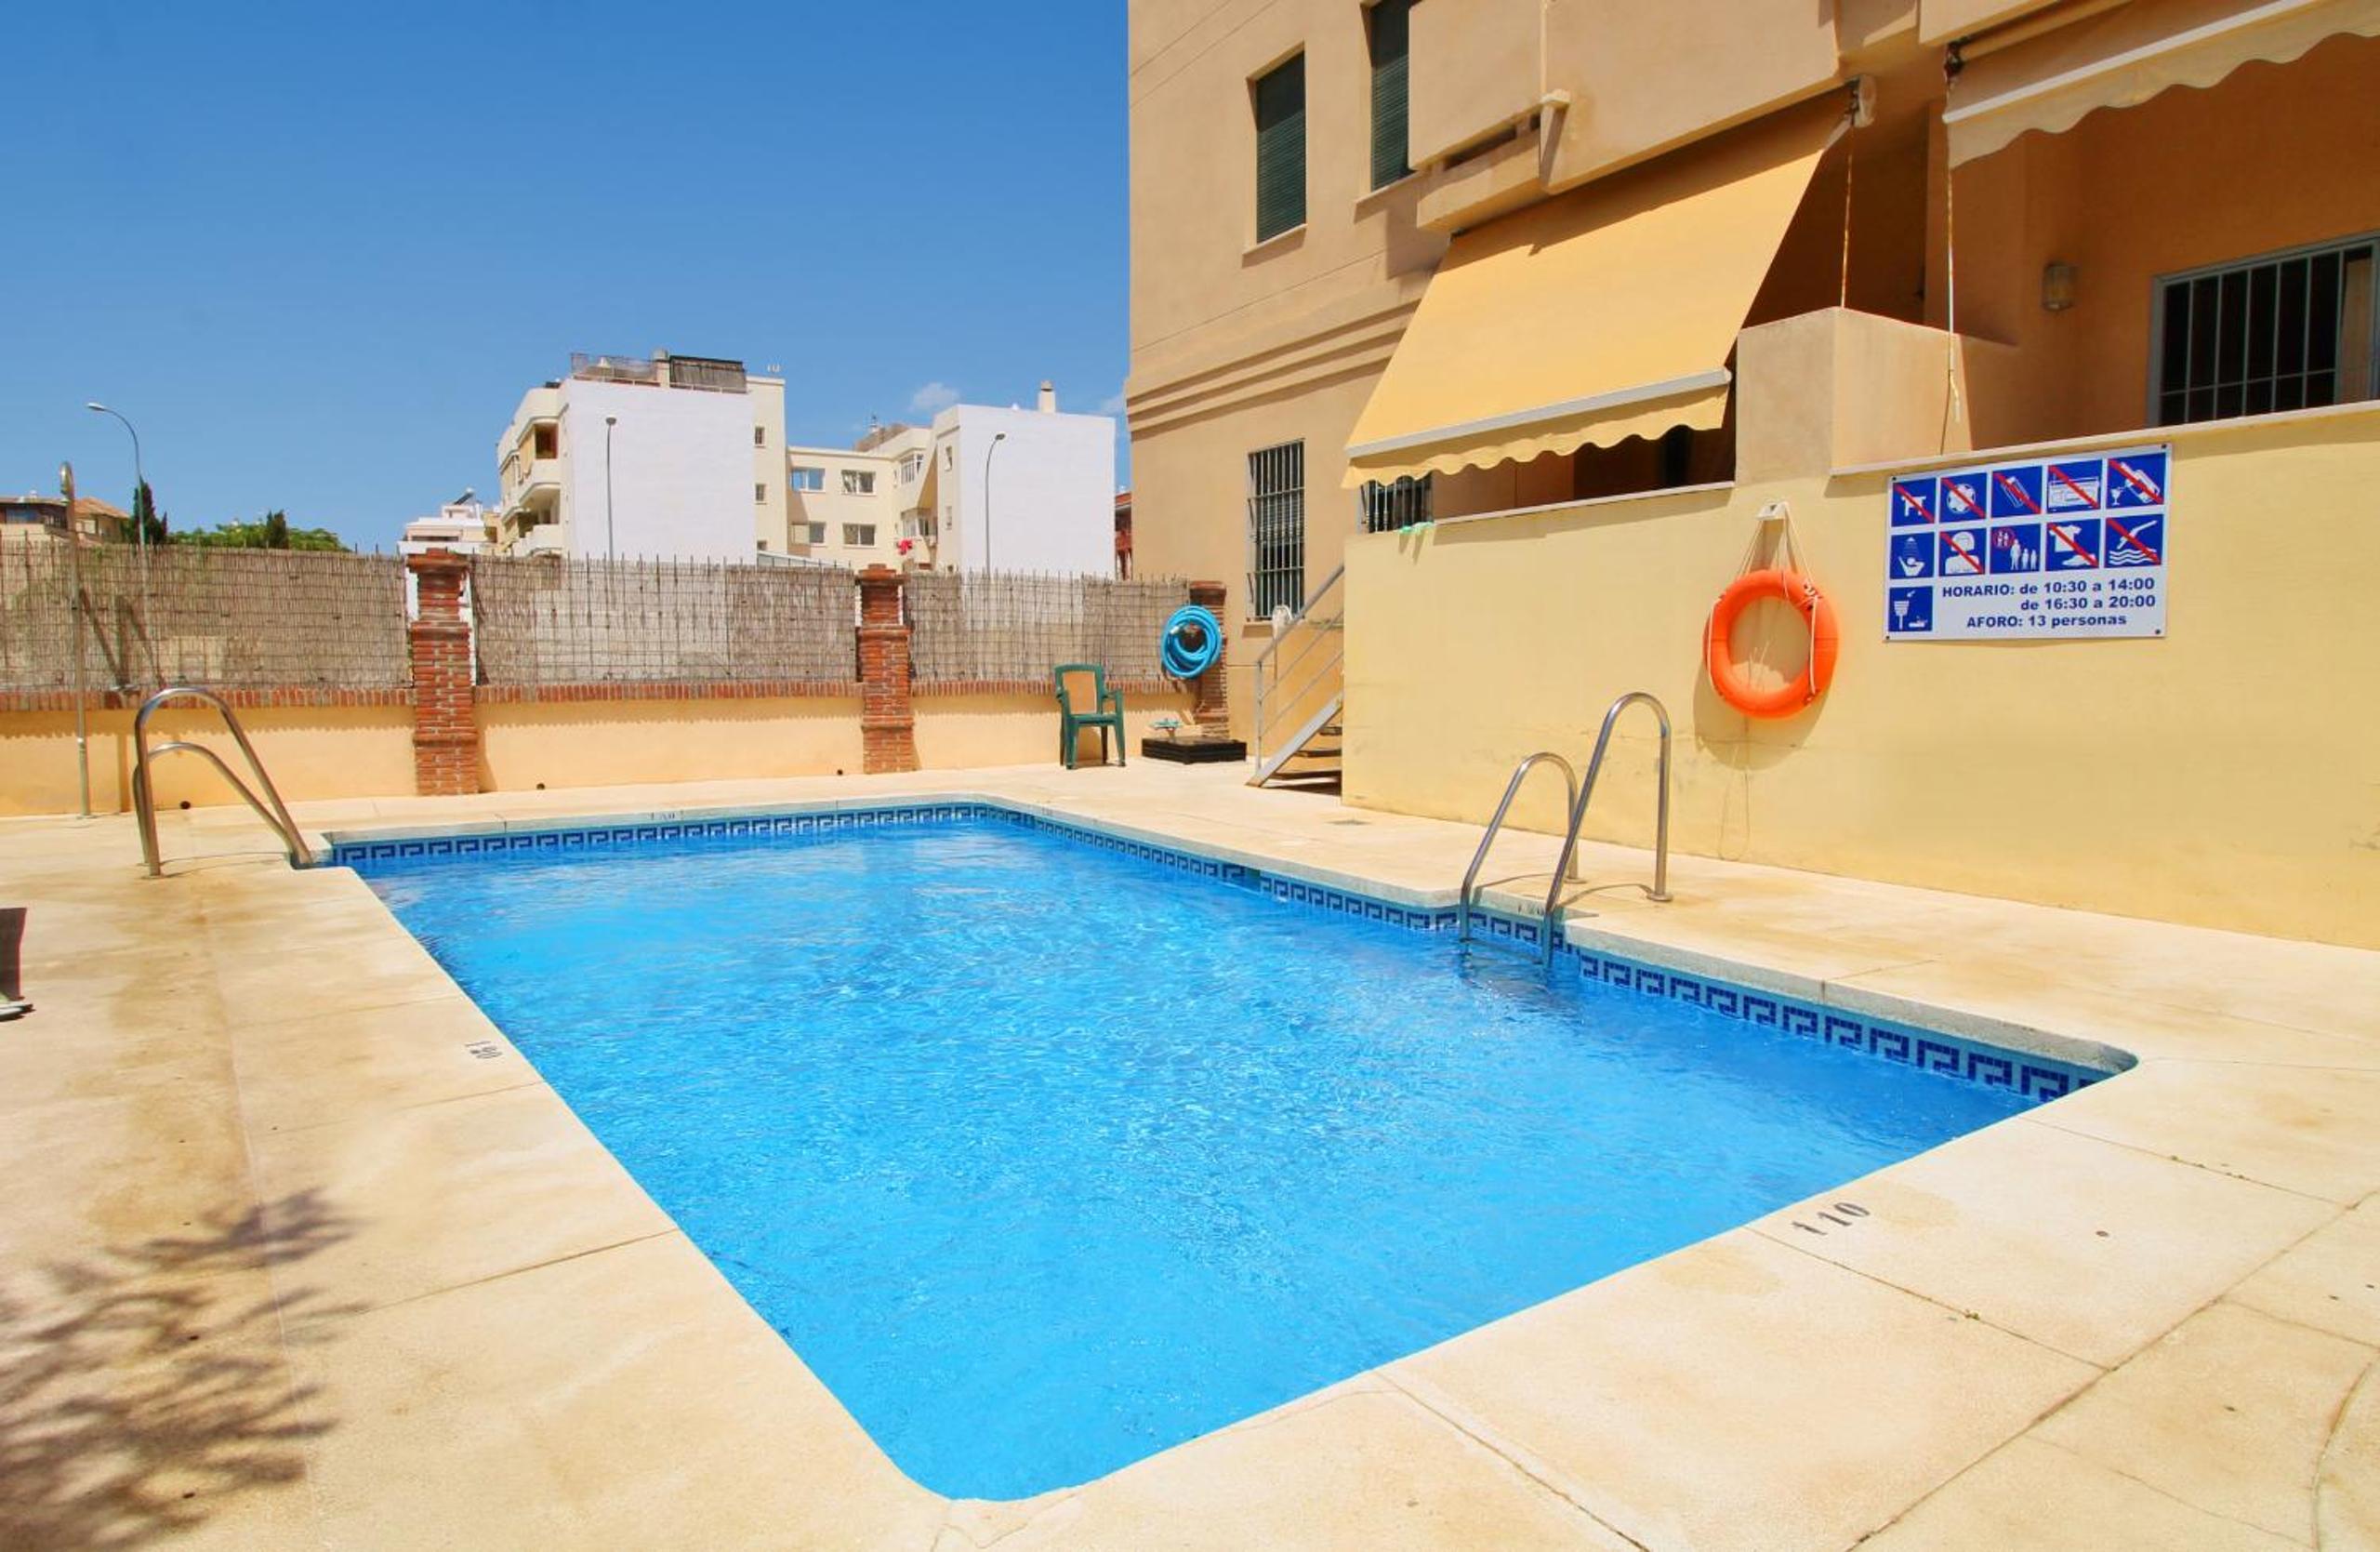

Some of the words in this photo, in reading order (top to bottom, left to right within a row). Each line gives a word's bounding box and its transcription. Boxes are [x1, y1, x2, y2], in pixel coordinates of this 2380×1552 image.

[1942, 584, 2015, 597] HORARIO:
[2019, 583, 2038, 594] de
[2044, 580, 2087, 593] 10:30
[2092, 582, 2102, 591] a
[2109, 577, 2155, 590] 14:00
[2020, 599, 2039, 610] de
[2045, 597, 2088, 610] 16:30
[2093, 599, 2103, 608] a
[2109, 595, 2155, 608] 20:00
[1967, 615, 2023, 628] AFORO:
[2029, 615, 2046, 627] 13
[2051, 616, 2127, 630] personas
[1791, 1201, 1871, 1236] 110
